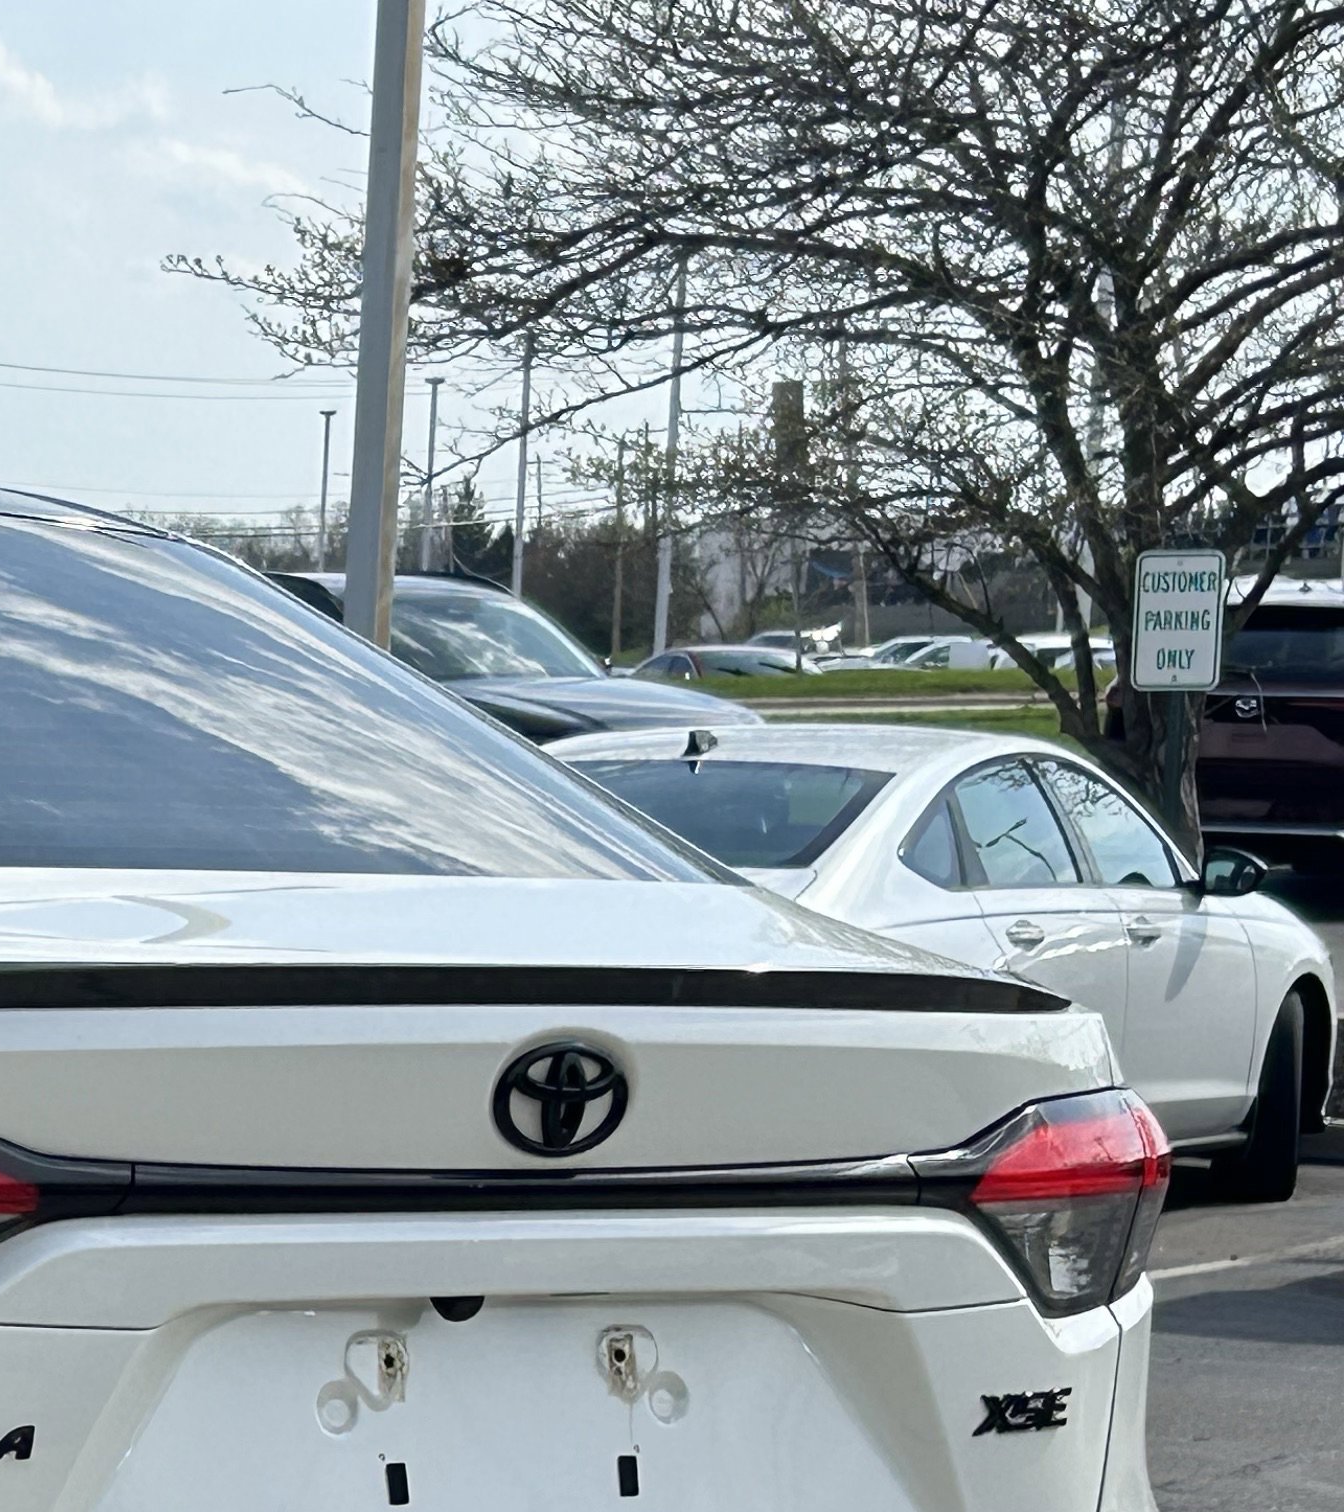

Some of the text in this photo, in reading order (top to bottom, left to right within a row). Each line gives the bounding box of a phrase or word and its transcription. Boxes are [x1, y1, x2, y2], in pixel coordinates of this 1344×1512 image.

[1142, 571, 1218, 593] CUSTOMER
[1144, 609, 1211, 631] PARKING
[1156, 648, 1195, 670] ONLY
[972, 1387, 1072, 1437] XSE
